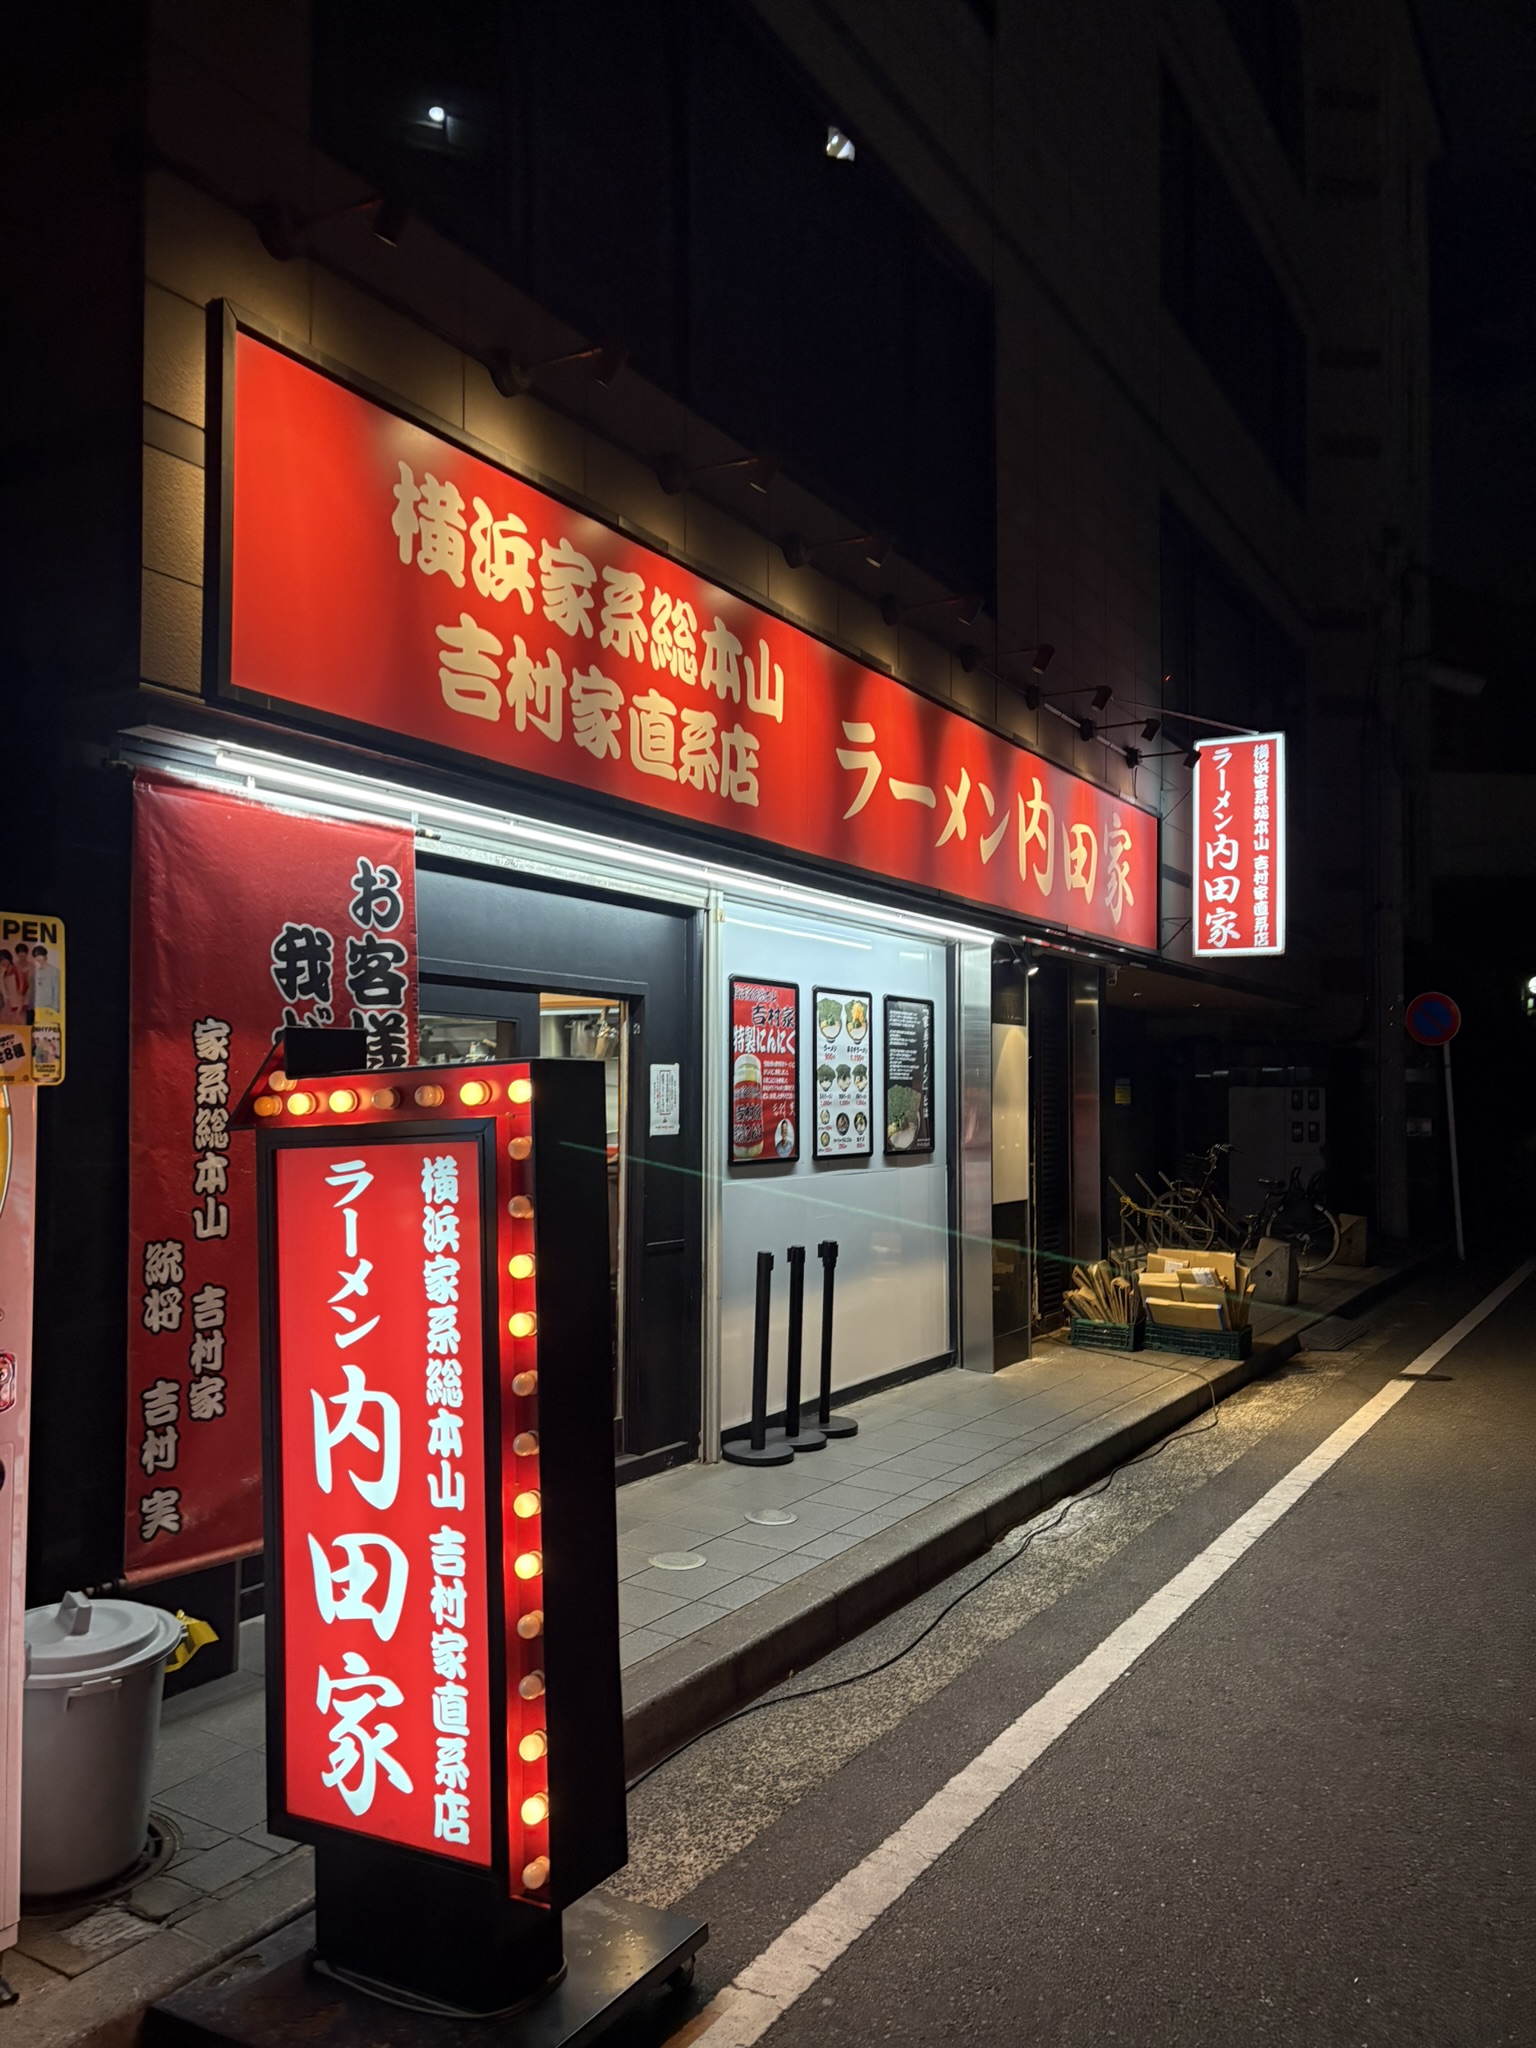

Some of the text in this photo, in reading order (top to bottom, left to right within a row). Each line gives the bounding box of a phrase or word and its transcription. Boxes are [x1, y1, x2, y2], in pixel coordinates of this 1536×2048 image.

[391, 460, 784, 723] 横浜家系総本山
[435, 612, 760, 807] 吉村家直系店
[752, 1002, 796, 1028] 吉村家
[192, 1017, 231, 1239] 家系総本山
[188, 1285, 228, 1421] 吉村家
[421, 1155, 471, 1845] 横浜家系総本山 吉村家直系店
